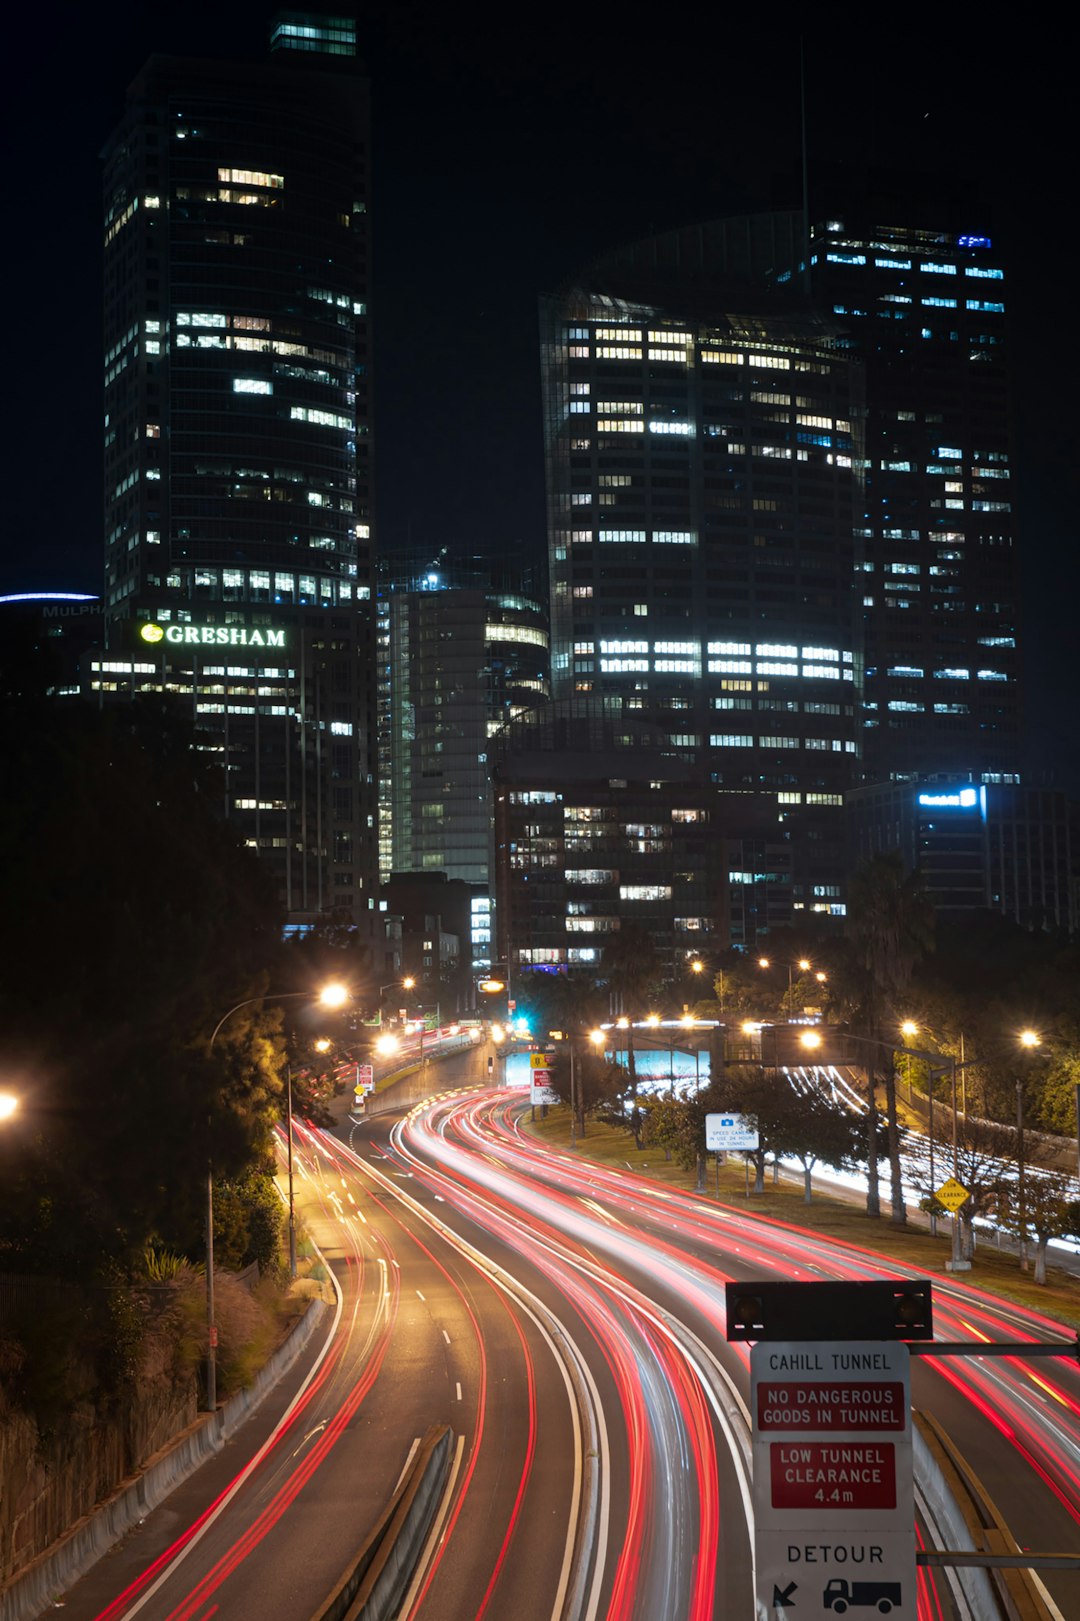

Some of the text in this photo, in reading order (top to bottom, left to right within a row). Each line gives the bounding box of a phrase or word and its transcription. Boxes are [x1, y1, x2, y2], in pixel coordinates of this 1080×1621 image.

[166, 626, 285, 646] GRESHAM
[769, 1354, 891, 1370] CAHILL TUNNEL
[768, 1390, 893, 1403] NO DANGEROUS
[763, 1409, 899, 1423] GOODS IN TUNNEL
[780, 1449, 884, 1463] LOW TUNNEL
[785, 1469, 881, 1483] CLEARANCE
[814, 1488, 853, 1502] 4.4m
[787, 1545, 883, 1563] DETOUR
